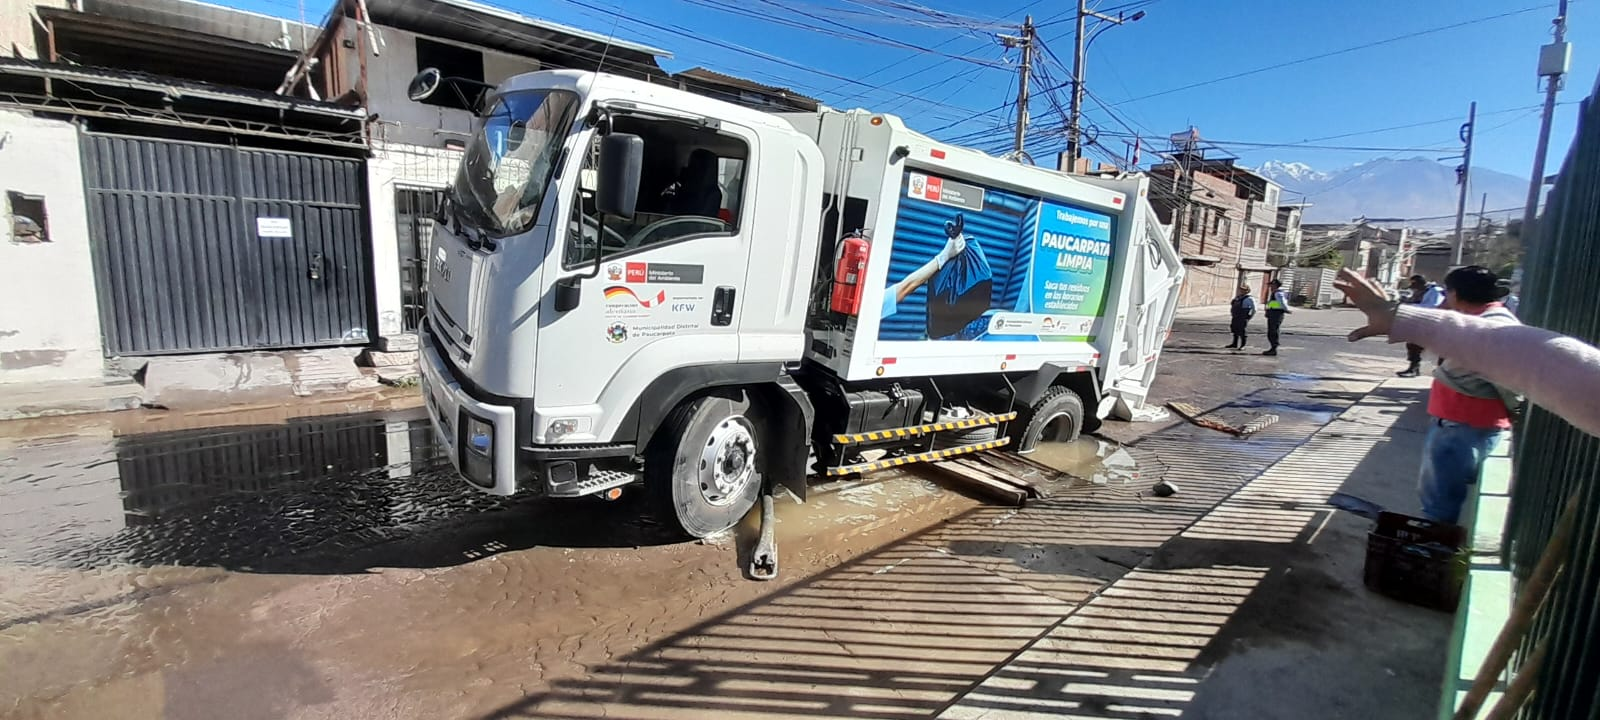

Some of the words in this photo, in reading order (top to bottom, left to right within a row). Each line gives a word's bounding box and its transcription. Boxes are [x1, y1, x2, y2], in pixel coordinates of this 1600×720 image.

[1057, 210, 1088, 225] Trabajemos
[1088, 219, 1098, 228] por
[1042, 232, 1110, 256] PAUCARPATA
[1056, 252, 1092, 270] LIMPIA
[1044, 280, 1059, 290] Saca
[1054, 292, 1062, 300] los
